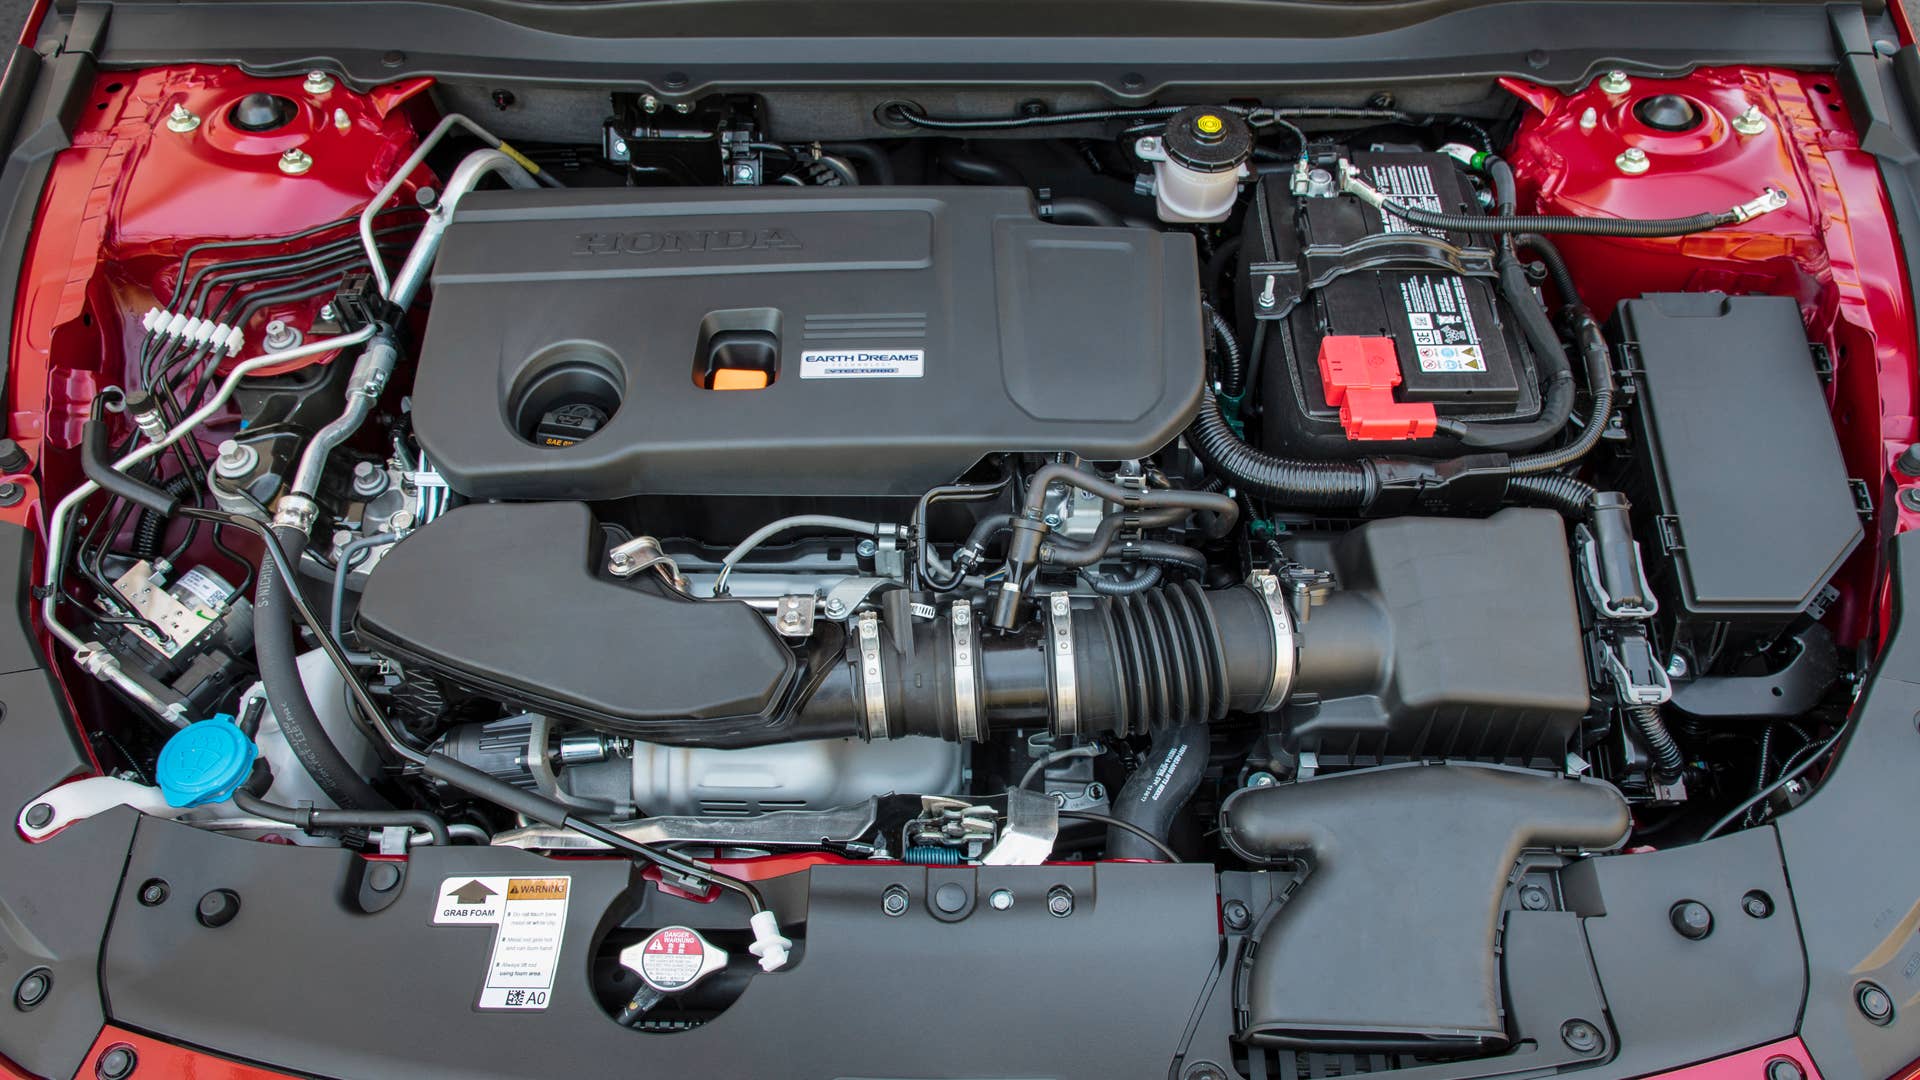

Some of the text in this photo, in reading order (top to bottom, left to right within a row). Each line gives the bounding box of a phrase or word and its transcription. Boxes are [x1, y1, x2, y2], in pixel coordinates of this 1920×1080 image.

[572, 228, 803, 255] HONDA
[1417, 331, 1431, 343] 3E
[858, 353, 919, 362] DREAMS
[546, 438, 561, 446] SAE
[520, 885, 564, 894] WARNING
[443, 909, 495, 917] GRAB FOAM
[526, 991, 546, 1005] A0
